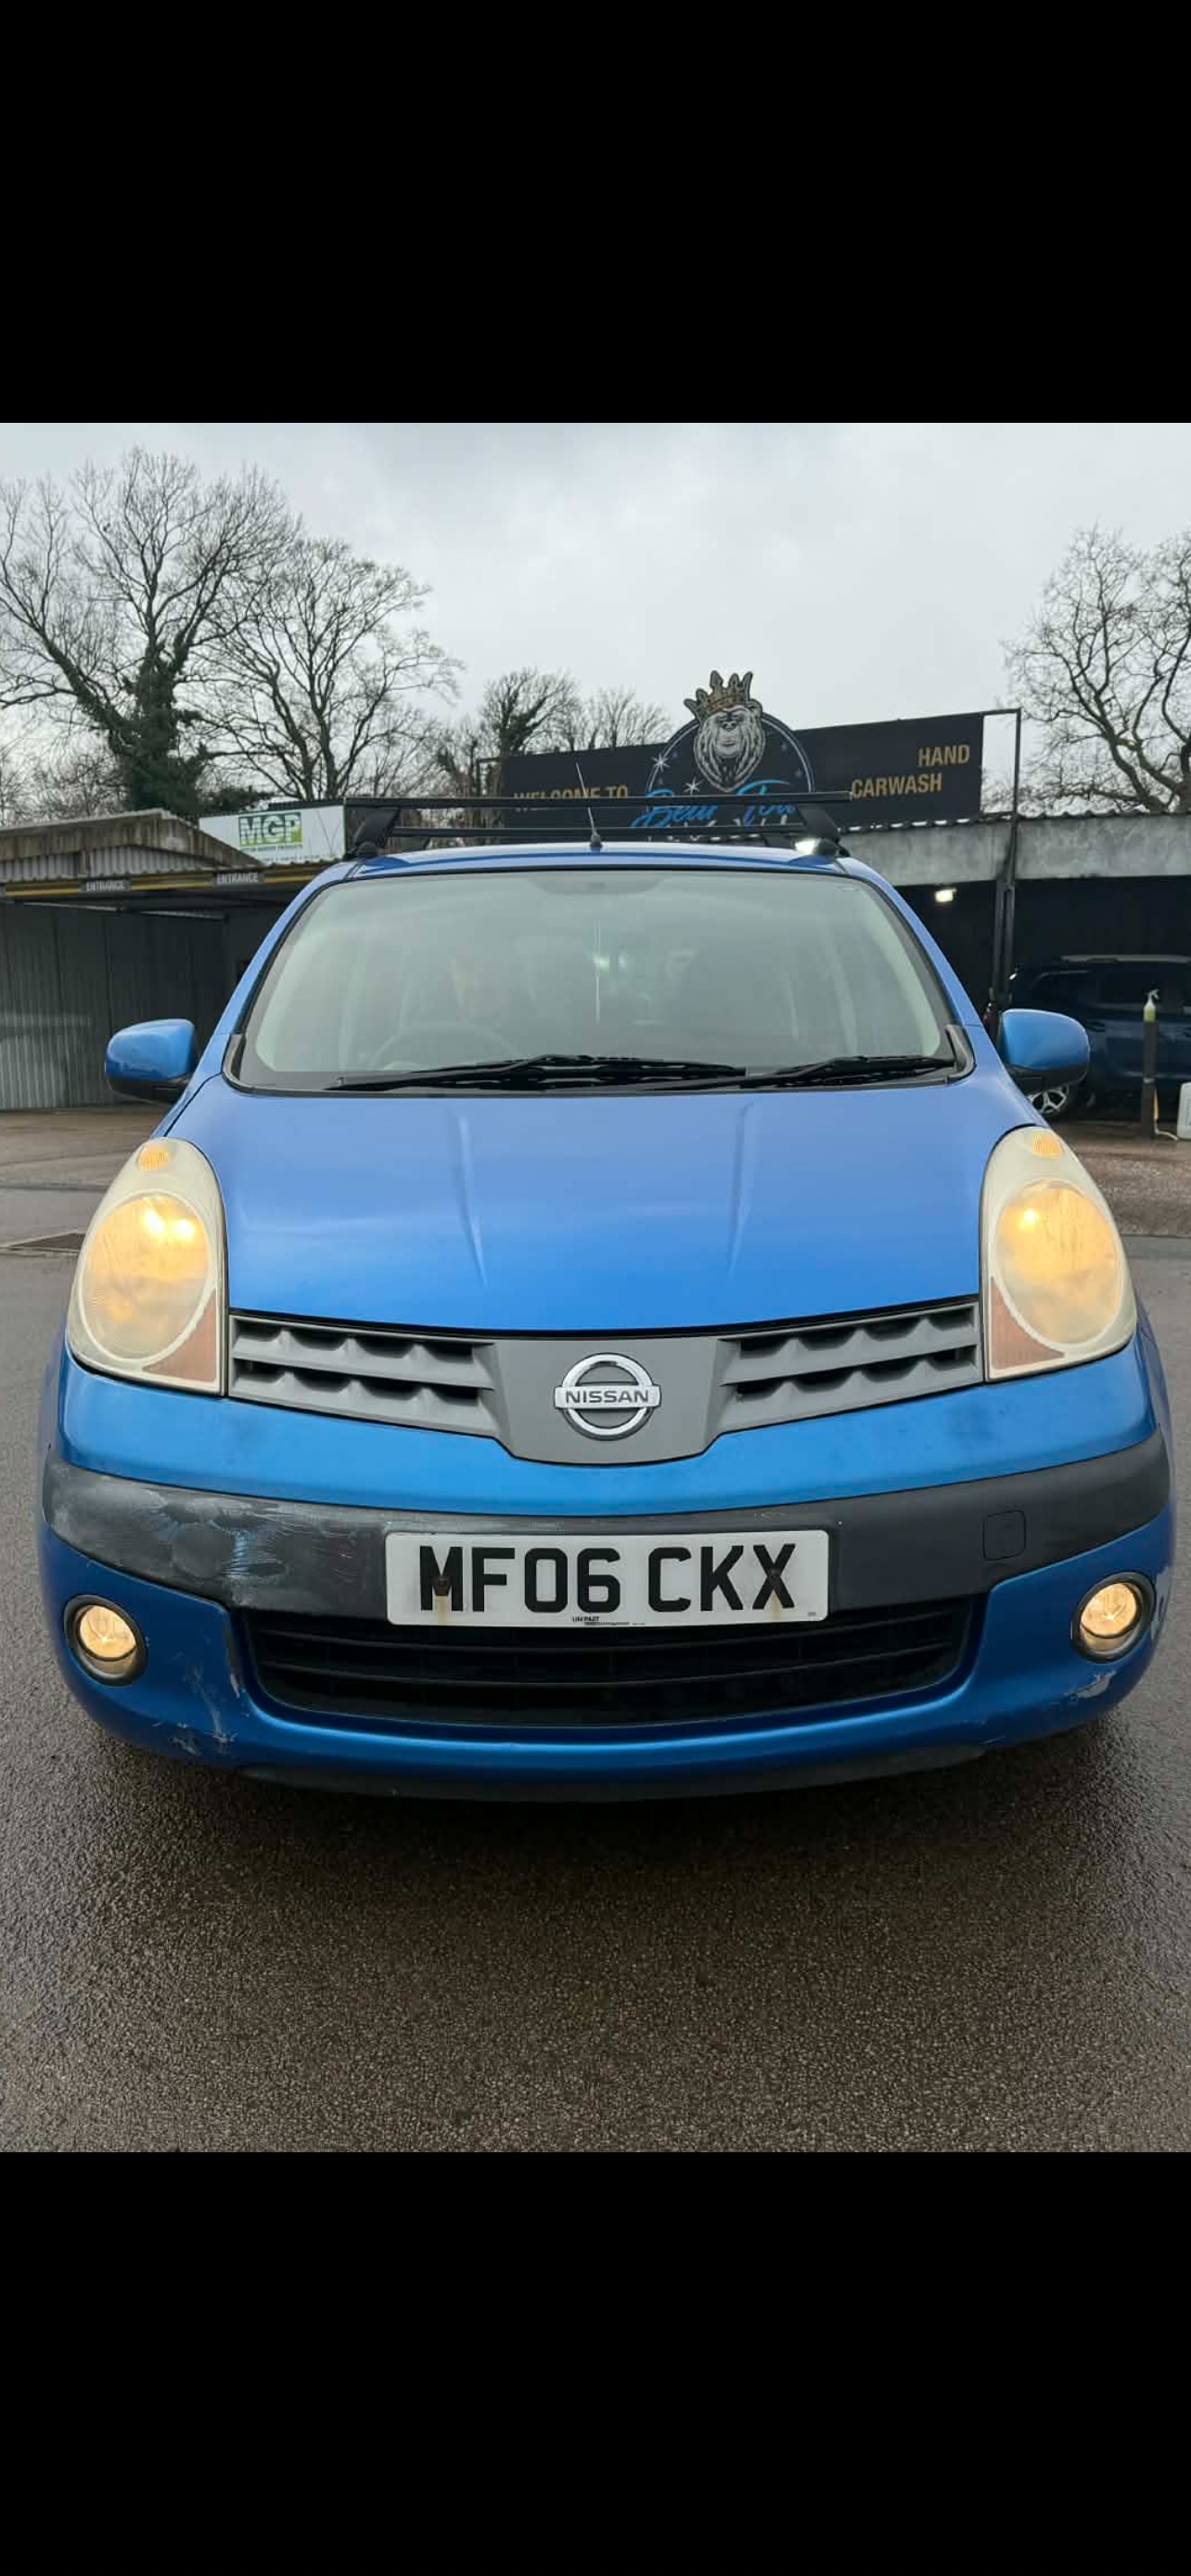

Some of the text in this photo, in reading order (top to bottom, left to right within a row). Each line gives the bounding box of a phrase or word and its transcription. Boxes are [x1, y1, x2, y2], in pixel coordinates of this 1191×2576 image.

[918, 745, 970, 767] HAND
[606, 784, 629, 799] TO
[852, 772, 942, 798] CARWASH
[239, 813, 301, 845] MGP
[85, 880, 125, 892] ENTRANCE
[216, 873, 260, 884] ENTRANCE
[565, 1389, 649, 1404] NISSAN
[419, 1543, 796, 1613] MF06 CKX
